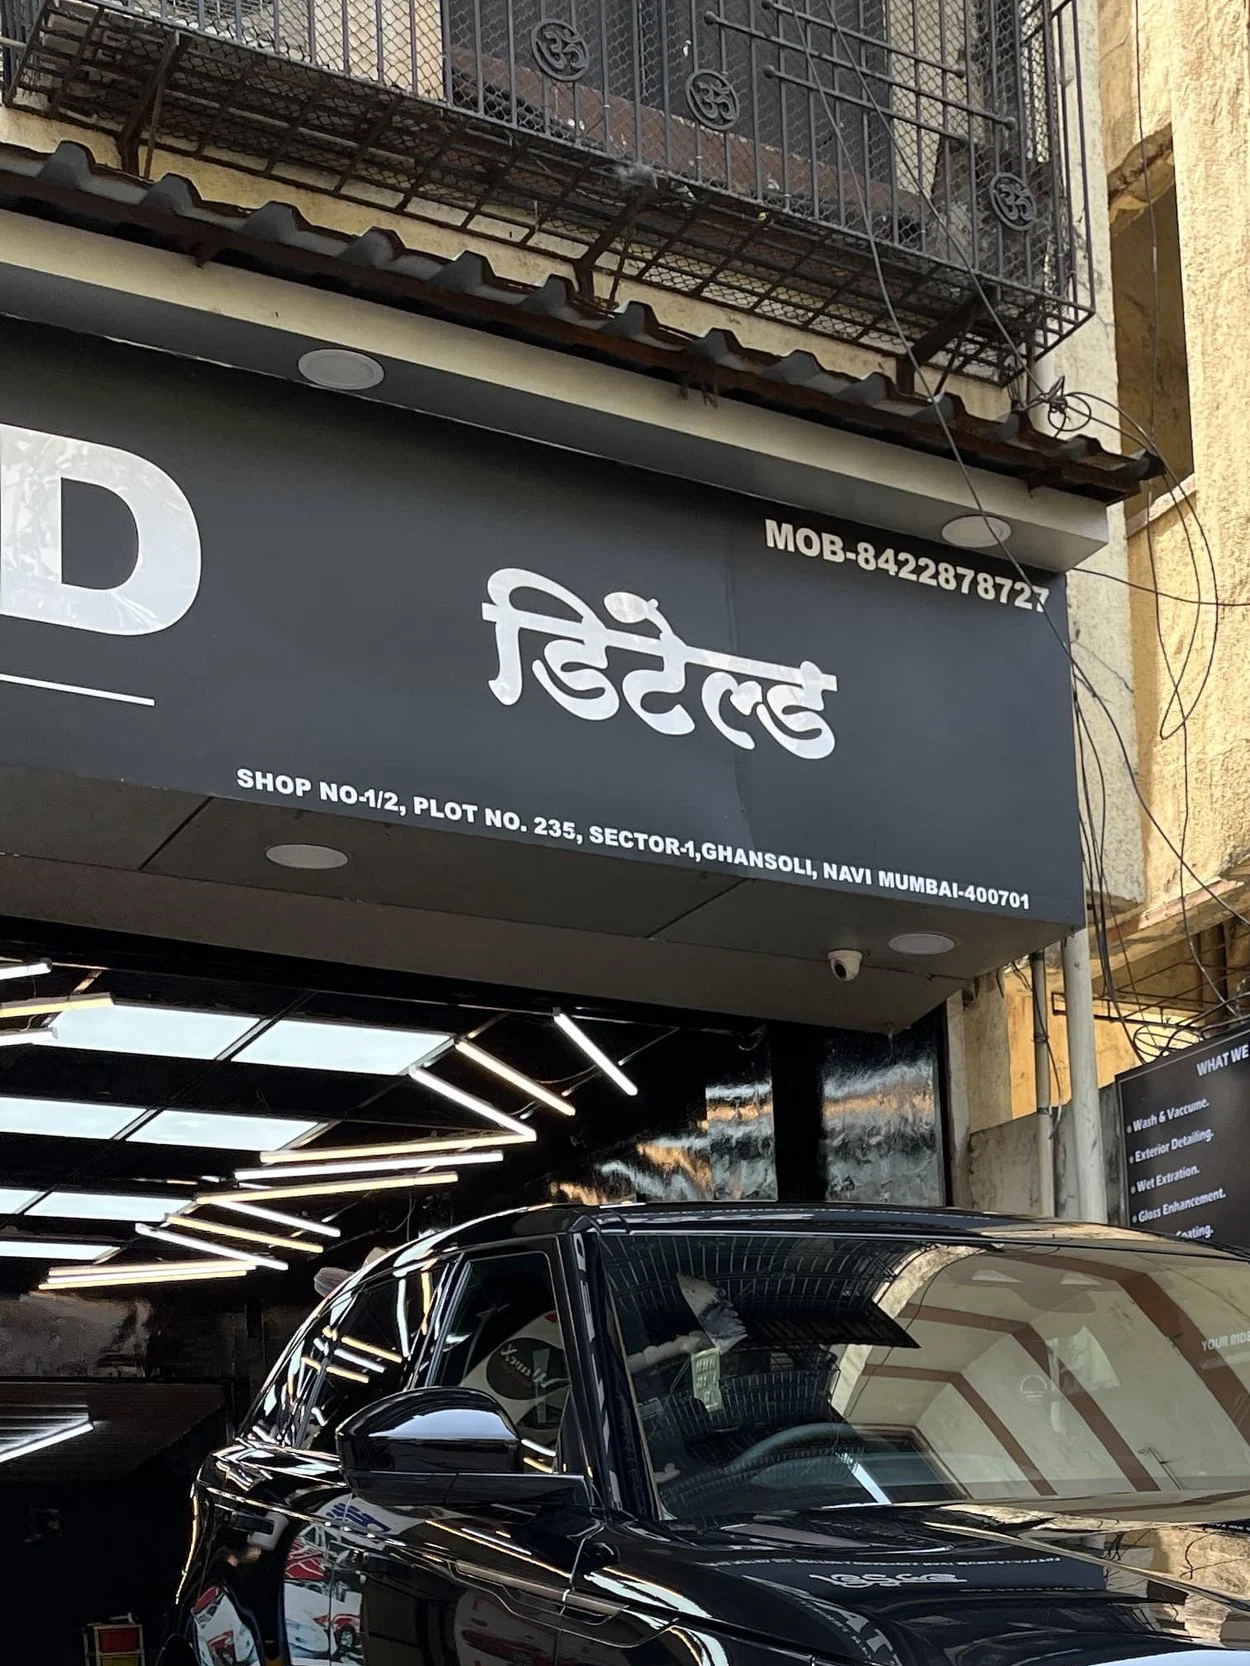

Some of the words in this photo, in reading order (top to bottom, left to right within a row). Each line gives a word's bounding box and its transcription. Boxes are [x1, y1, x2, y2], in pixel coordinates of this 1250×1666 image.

[764, 518, 1050, 613] MOB-8422878727
[481, 567, 838, 760] डिटेल्ड
[236, 768, 312, 797] SHOP
[319, 781, 407, 816] NO-1/2,
[413, 796, 478, 824] PLOT
[484, 807, 528, 833] NO.
[533, 816, 583, 846] 235,
[823, 862, 872, 886] NAVI
[878, 870, 1031, 911] MUMBAI-400701
[1196, 1052, 1230, 1076] WHAT
[1230, 1044, 1250, 1063] WE
[1132, 1114, 1158, 1133] Wash
[1158, 1111, 1167, 1123] &
[1167, 1098, 1210, 1120] Vaccume.
[1134, 1142, 1170, 1163] Exterior
[1171, 1128, 1214, 1151] Detailing.
[1136, 1178, 1156, 1193] Wet
[1155, 1165, 1200, 1187] Extration.
[1138, 1206, 1162, 1223] Gloss
[1162, 1187, 1227, 1216] Enhancement.
[1201, 1335, 1229, 1352] YOUR
